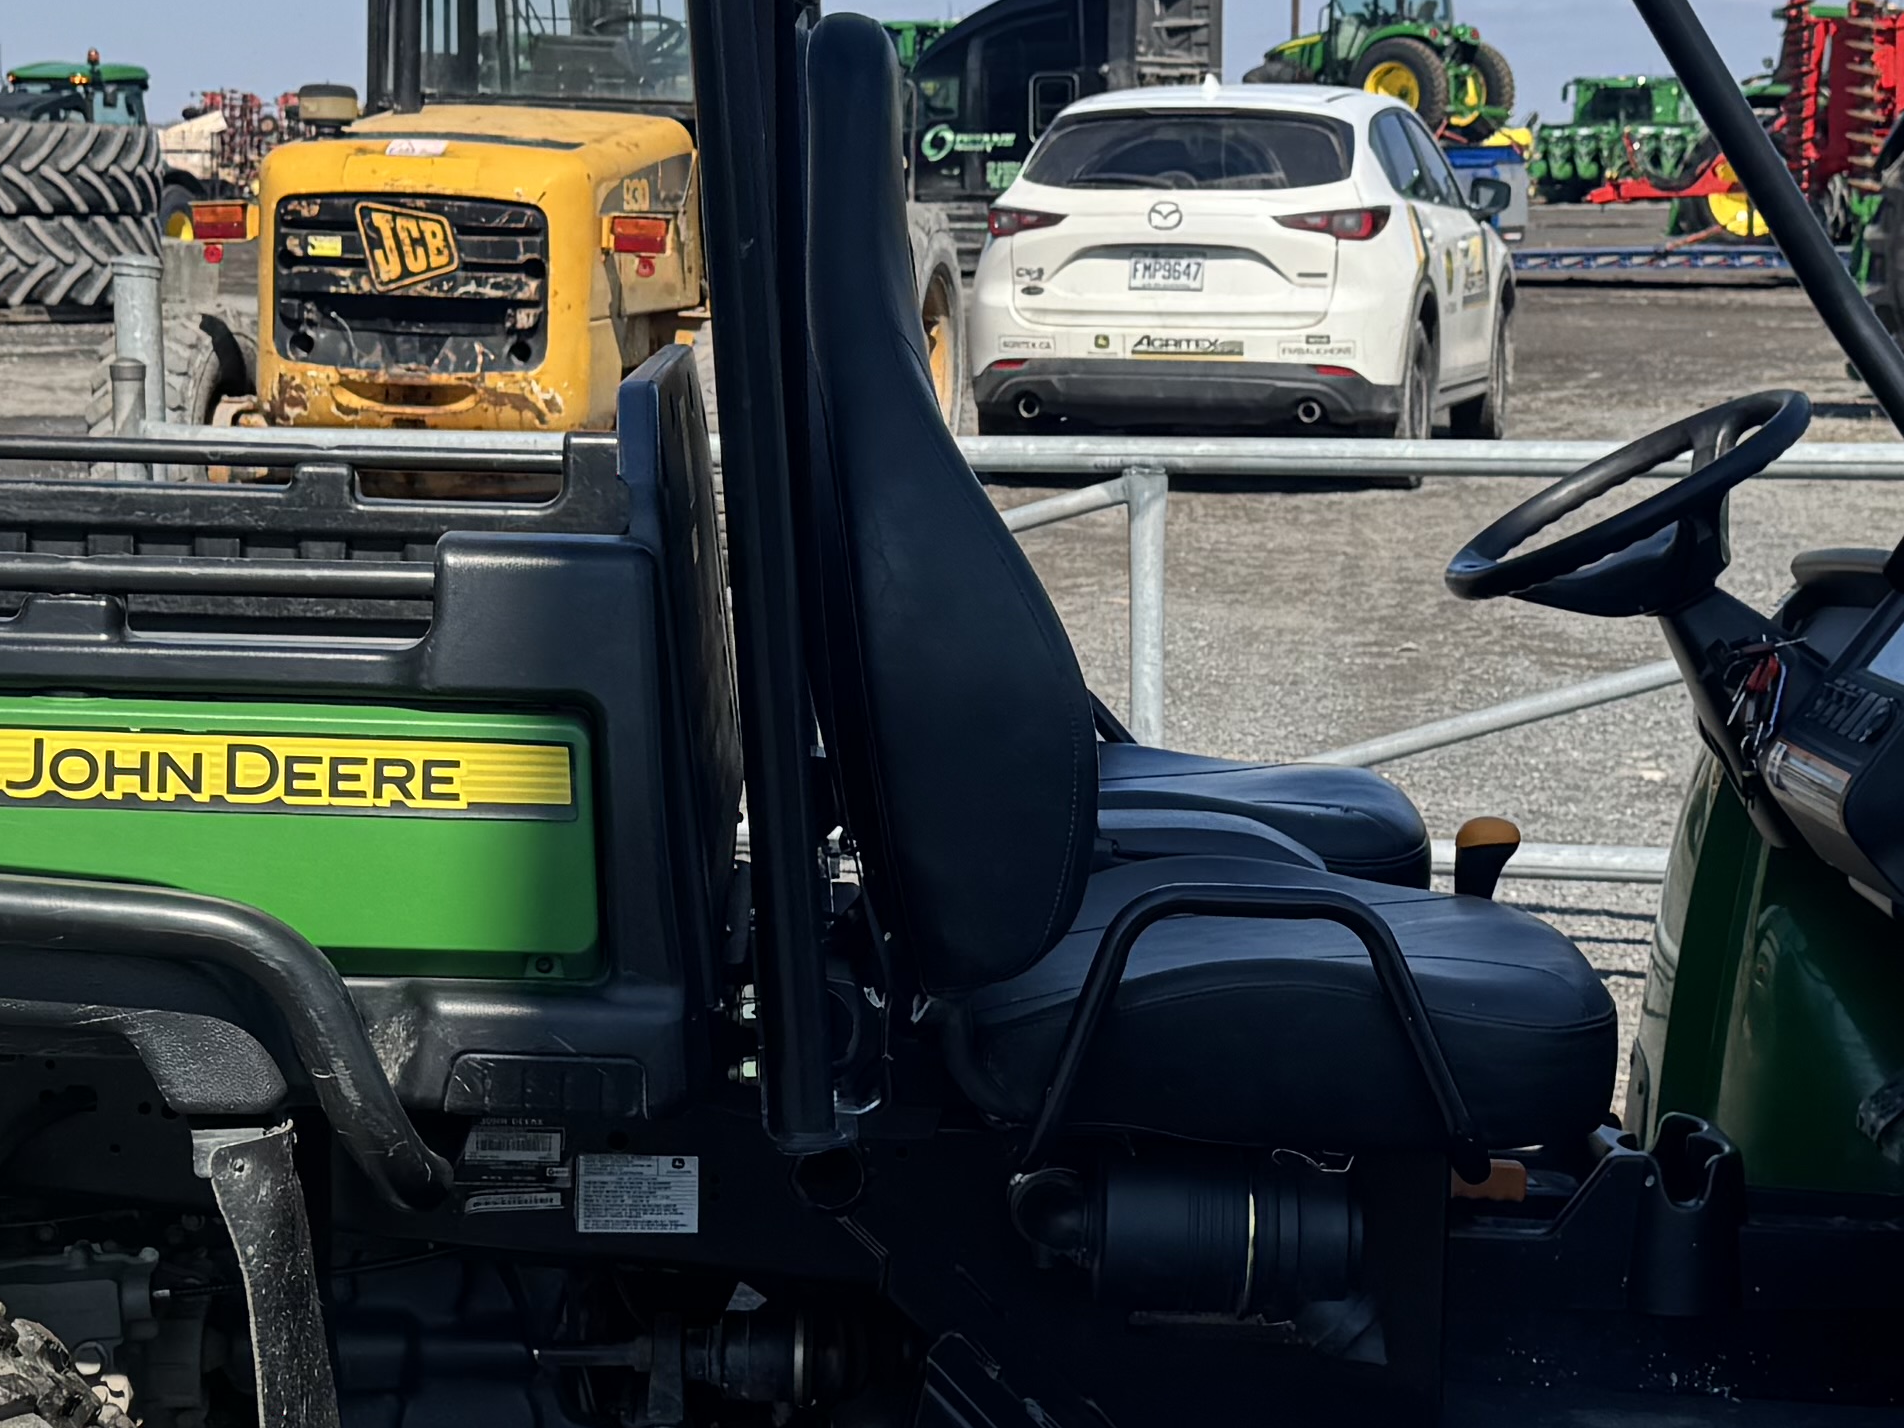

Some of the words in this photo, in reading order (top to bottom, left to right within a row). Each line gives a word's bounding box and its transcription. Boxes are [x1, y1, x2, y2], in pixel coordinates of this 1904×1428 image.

[370, 211, 450, 283] JCB
[1132, 261, 1202, 282] FMP9647
[5, 737, 205, 796] JOHN
[226, 743, 463, 801] DEERE
